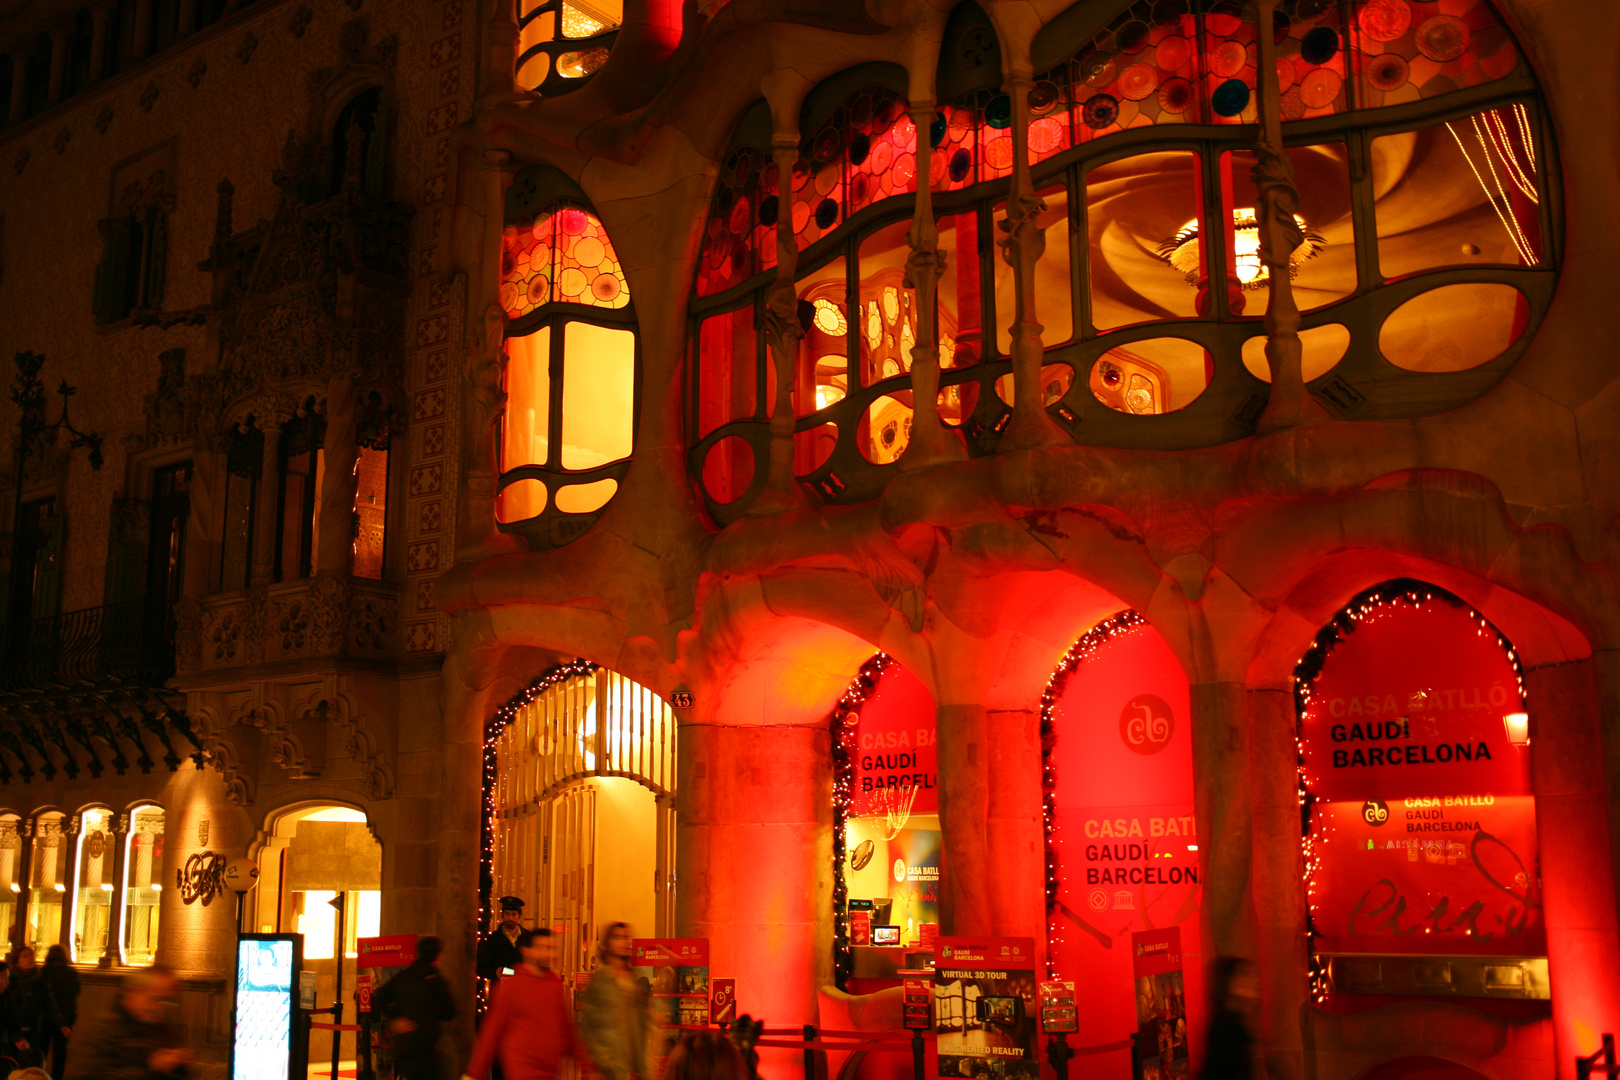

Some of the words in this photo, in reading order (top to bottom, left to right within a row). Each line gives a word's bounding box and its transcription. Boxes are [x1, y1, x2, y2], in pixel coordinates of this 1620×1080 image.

[674, 693, 690, 707] 43
[1328, 694, 1400, 718] CASA
[1409, 682, 1508, 712] BATLLÓ
[861, 730, 911, 750] CASA
[862, 748, 917, 771] GAUDÍ
[1333, 742, 1493, 769] BARCELONA
[863, 773, 937, 792] BARCEL
[1404, 796, 1441, 808] CASA
[1444, 792, 1495, 808] BATLLÓ
[1405, 807, 1444, 820] GAUDÍ
[1084, 818, 1143, 839] CASA
[1406, 821, 1482, 833] BARCELONA
[1086, 839, 1149, 861] GAUDÍ
[907, 866, 922, 875] CASA
[1087, 867, 1202, 885] BARCELON
[941, 970, 973, 979] VIRTUAL
[974, 971, 985, 979] 3D
[986, 971, 1007, 980] TOUR
[944, 1044, 991, 1055] AUGMENTED
[992, 1046, 1025, 1057] REALITY
